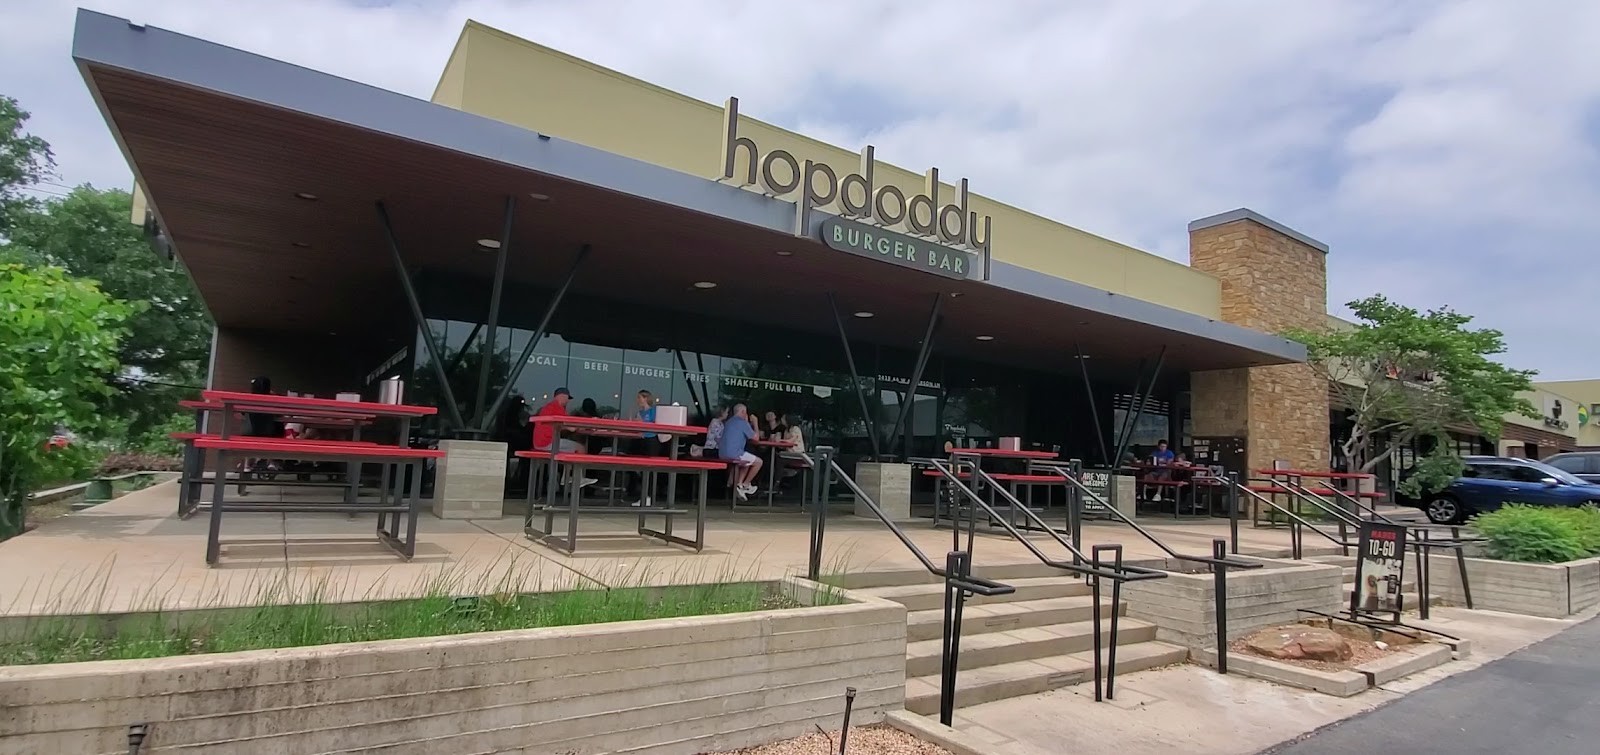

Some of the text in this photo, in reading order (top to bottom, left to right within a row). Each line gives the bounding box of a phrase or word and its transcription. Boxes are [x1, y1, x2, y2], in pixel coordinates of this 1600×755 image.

[723, 96, 991, 281] hopdoddy
[833, 224, 963, 274] BURGER BAR
[527, 355, 802, 394] OCAL BEER BURGERS FRIES SHAKES FULL BAR
[1083, 473, 1109, 482] ARE YOU
[1369, 539, 1395, 557] TO-GO
